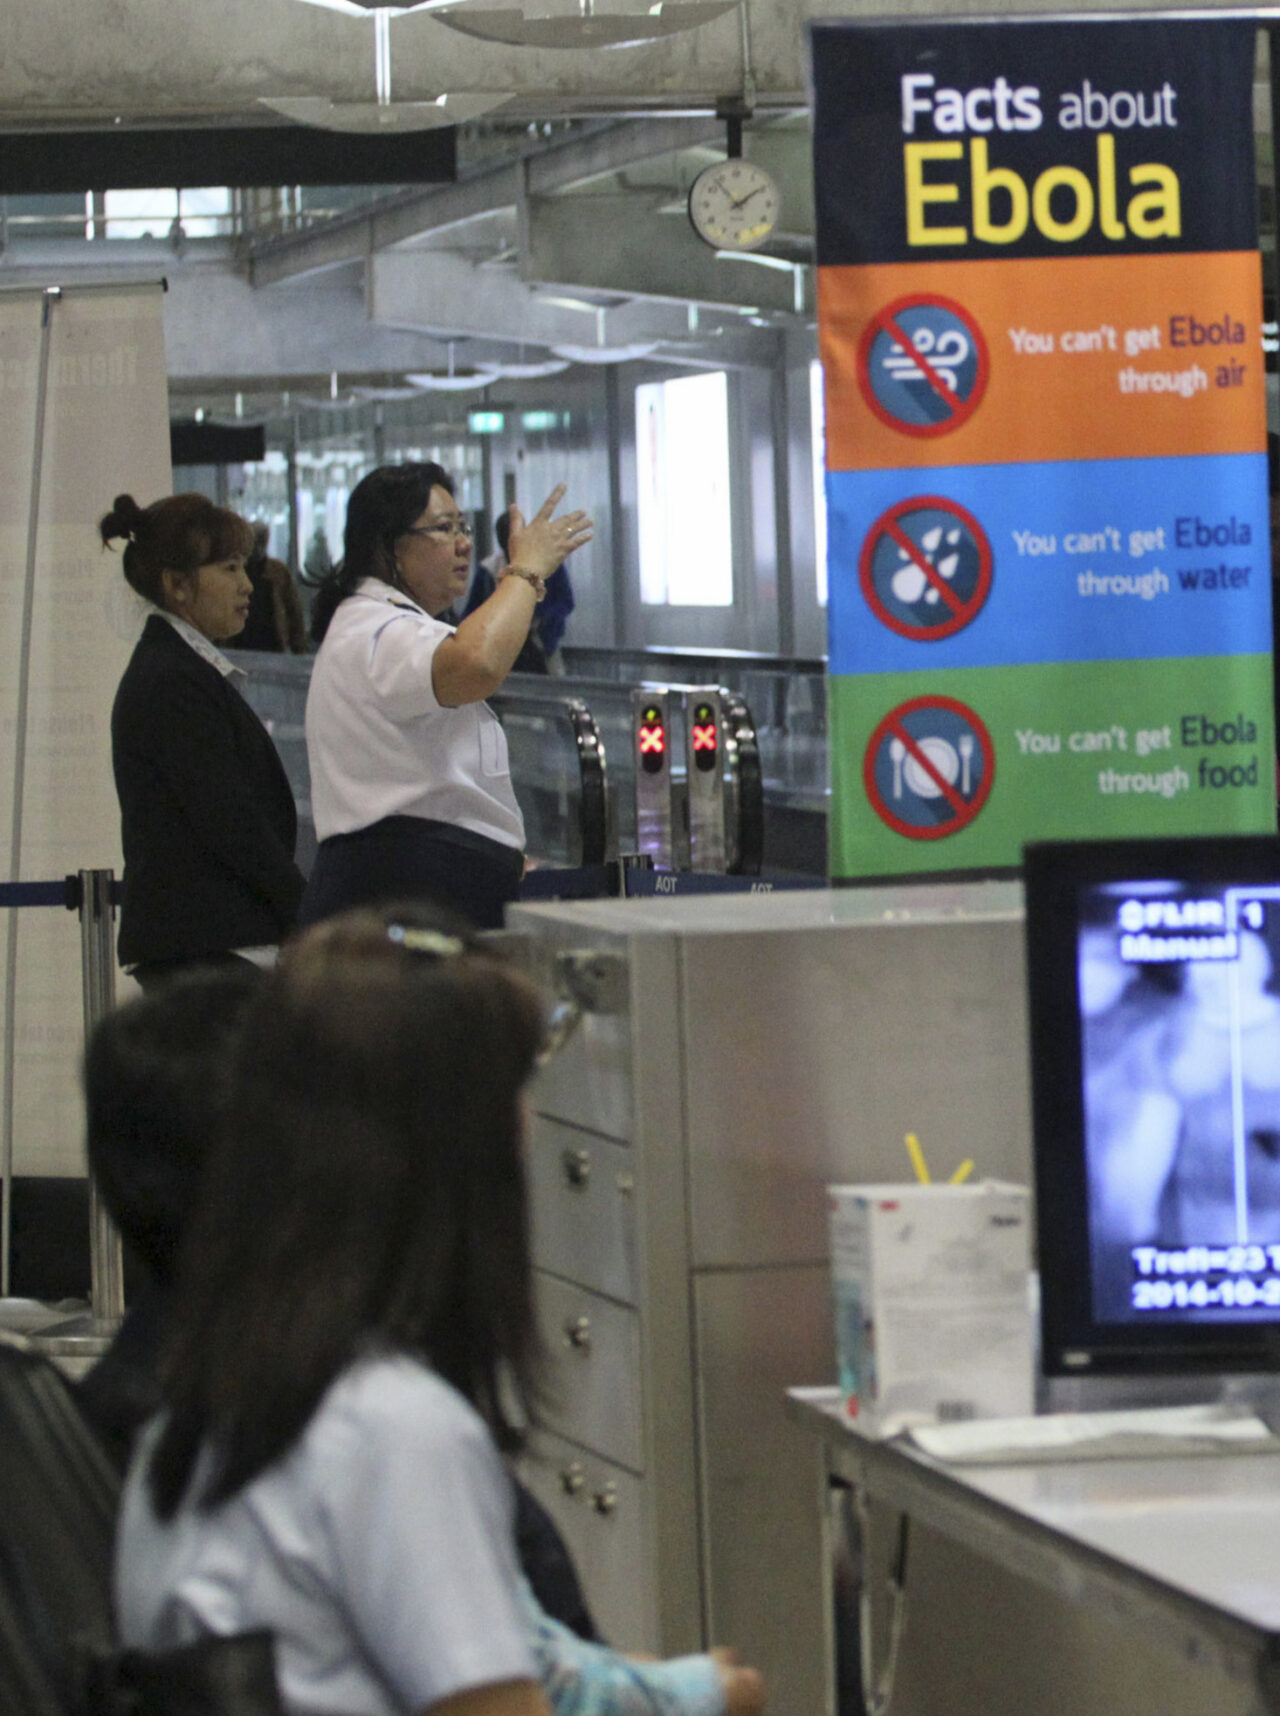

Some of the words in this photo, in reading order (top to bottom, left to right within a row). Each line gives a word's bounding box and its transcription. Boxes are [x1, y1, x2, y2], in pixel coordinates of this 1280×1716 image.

[901, 73, 1042, 133] Facts
[1058, 79, 1177, 129] about
[903, 133, 1181, 246] Ebola
[1009, 327, 1054, 355] You
[1061, 325, 1116, 352] can't
[1125, 322, 1160, 356] get
[1169, 315, 1246, 348] Ebola
[1118, 366, 1207, 398] through
[1215, 358, 1246, 389] air
[1012, 529, 1056, 556] You
[1063, 526, 1121, 554] can't
[1129, 526, 1165, 558] get
[1175, 517, 1252, 549] Ebola
[1077, 567, 1169, 600] through
[1178, 562, 1252, 591] water
[1015, 729, 1061, 755] You
[1069, 725, 1127, 753] can't
[1136, 726, 1171, 757] get
[1181, 714, 1257, 748] Ebola
[1099, 765, 1189, 799] through
[1199, 756, 1258, 790] food
[655, 875, 677, 893] AOT
